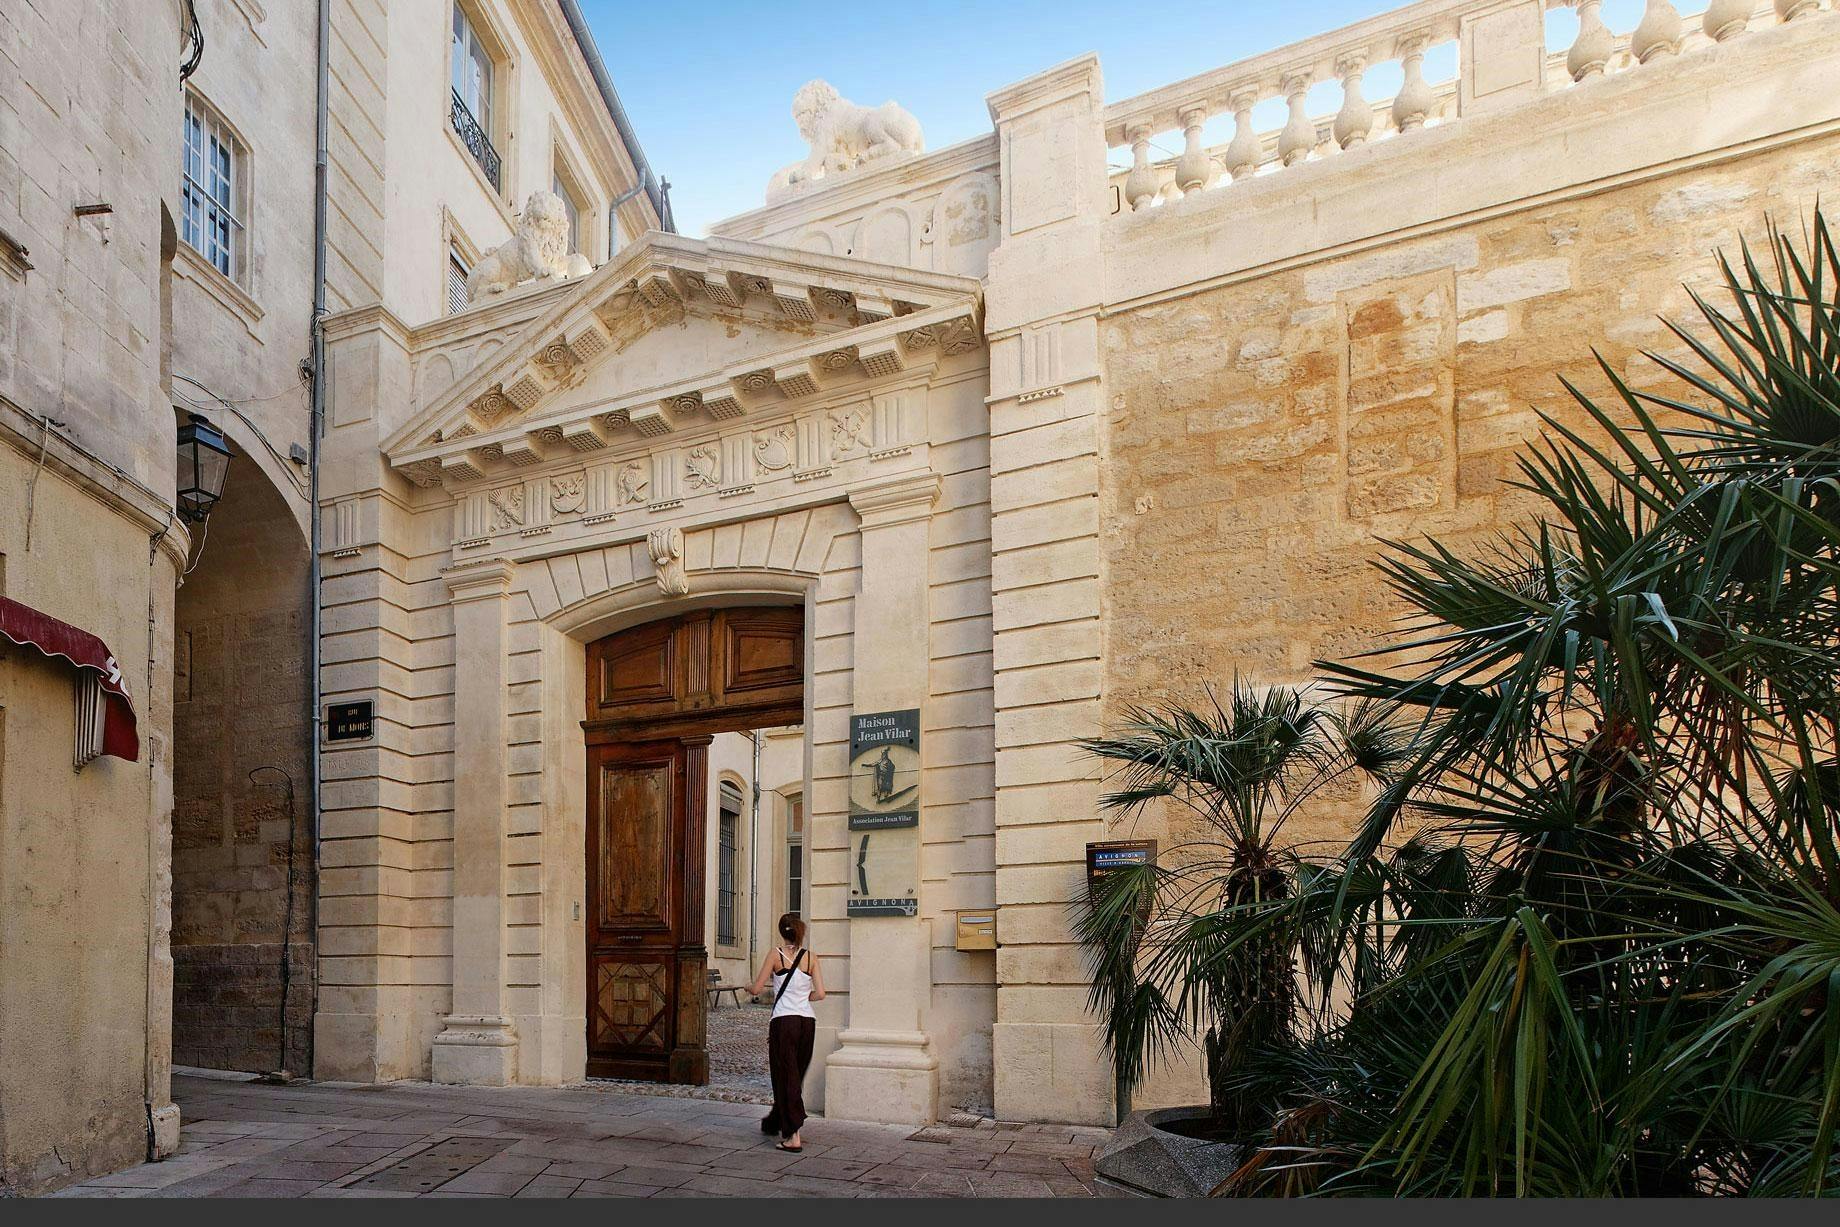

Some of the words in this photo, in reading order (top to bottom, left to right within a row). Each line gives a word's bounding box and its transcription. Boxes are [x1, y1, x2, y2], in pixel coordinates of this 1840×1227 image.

[858, 716, 895, 729] Maison
[858, 731, 884, 742] Jean
[884, 727, 911, 740] Vilar
[853, 816, 884, 825] Association
[849, 899, 906, 907] AVIGNON
